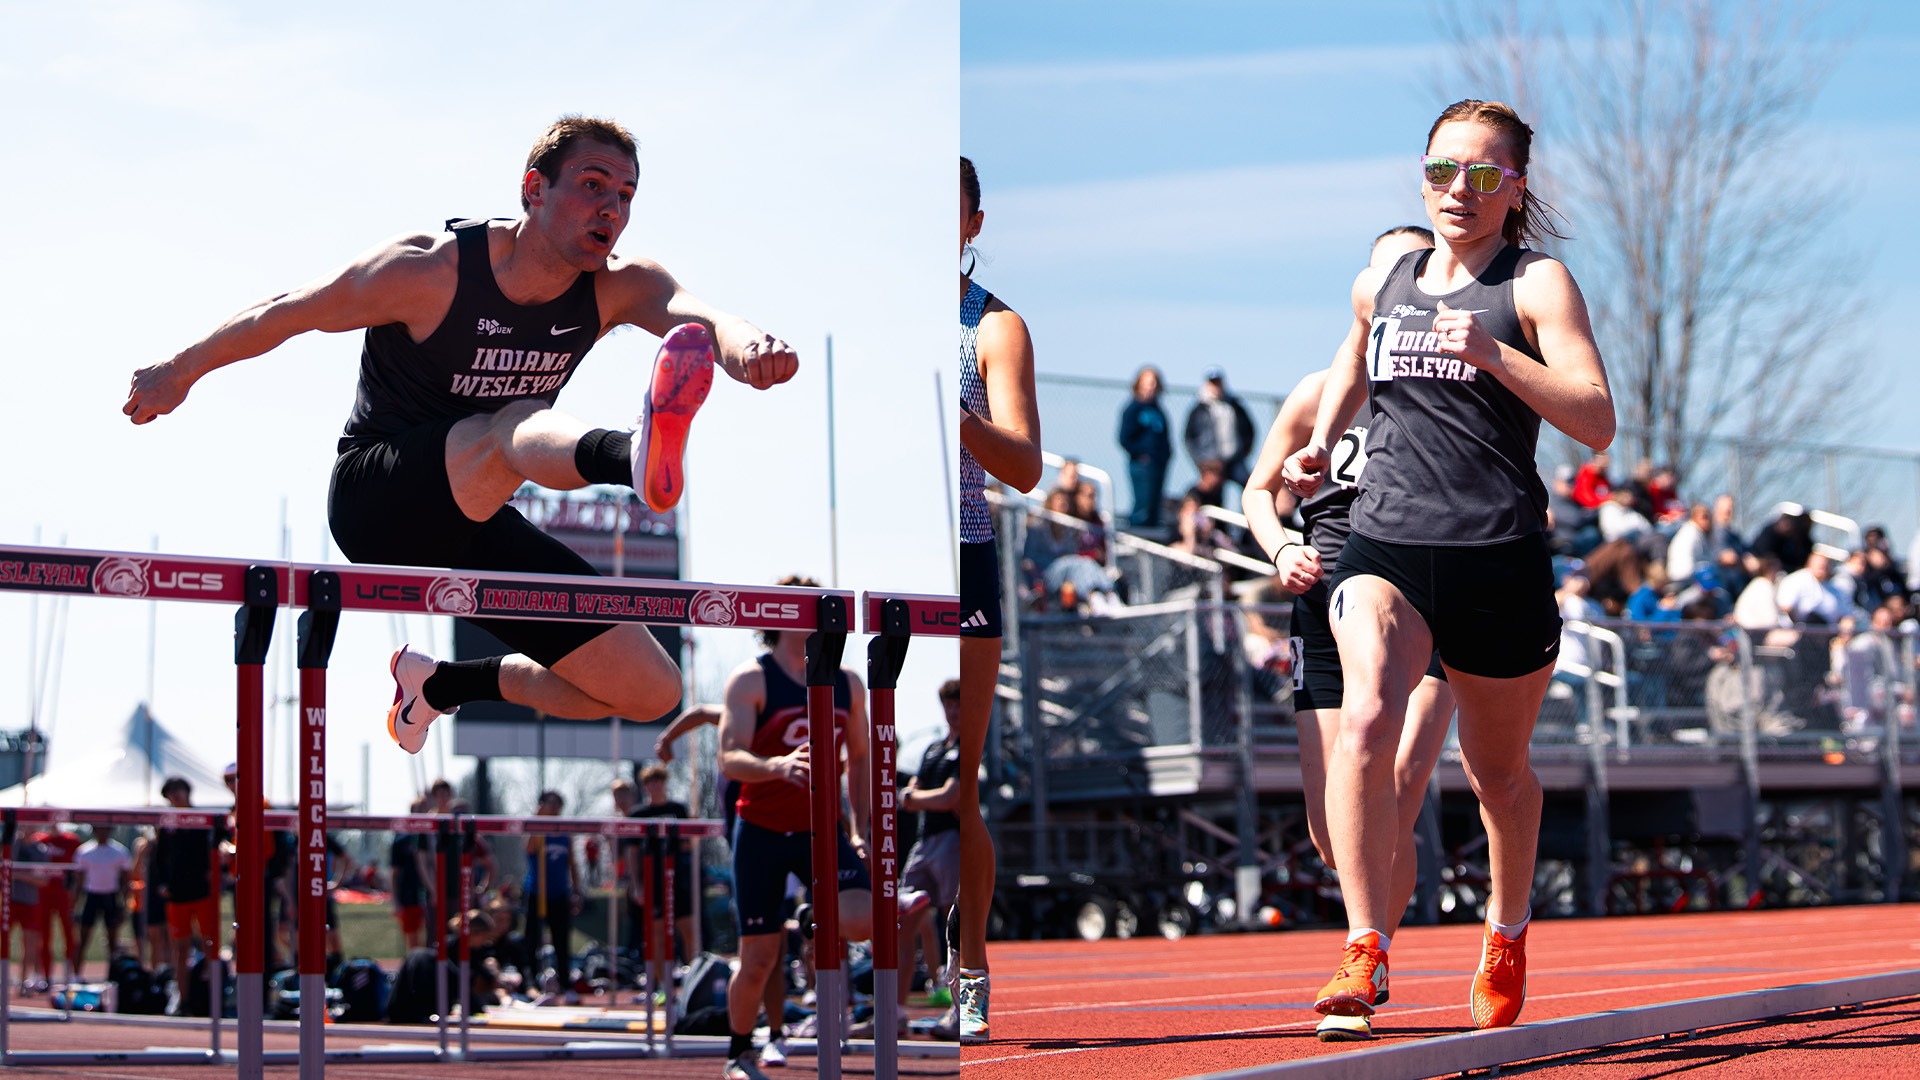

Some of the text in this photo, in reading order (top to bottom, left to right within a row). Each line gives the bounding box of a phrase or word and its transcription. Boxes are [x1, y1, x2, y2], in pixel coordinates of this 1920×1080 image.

[471, 347, 572, 372] INDIANA
[1373, 321, 1387, 377] 1
[1389, 355, 1477, 382] ESLEYAN
[1337, 433, 1360, 483] 2
[153, 570, 223, 592] UCS
[356, 583, 800, 620] UCS INDIANA WESLEYAN UCS
[921, 610, 960, 626] UC
[1335, 588, 1344, 621] 1
[305, 707, 326, 897] WILDCATS
[876, 724, 895, 898] WILDCATS
